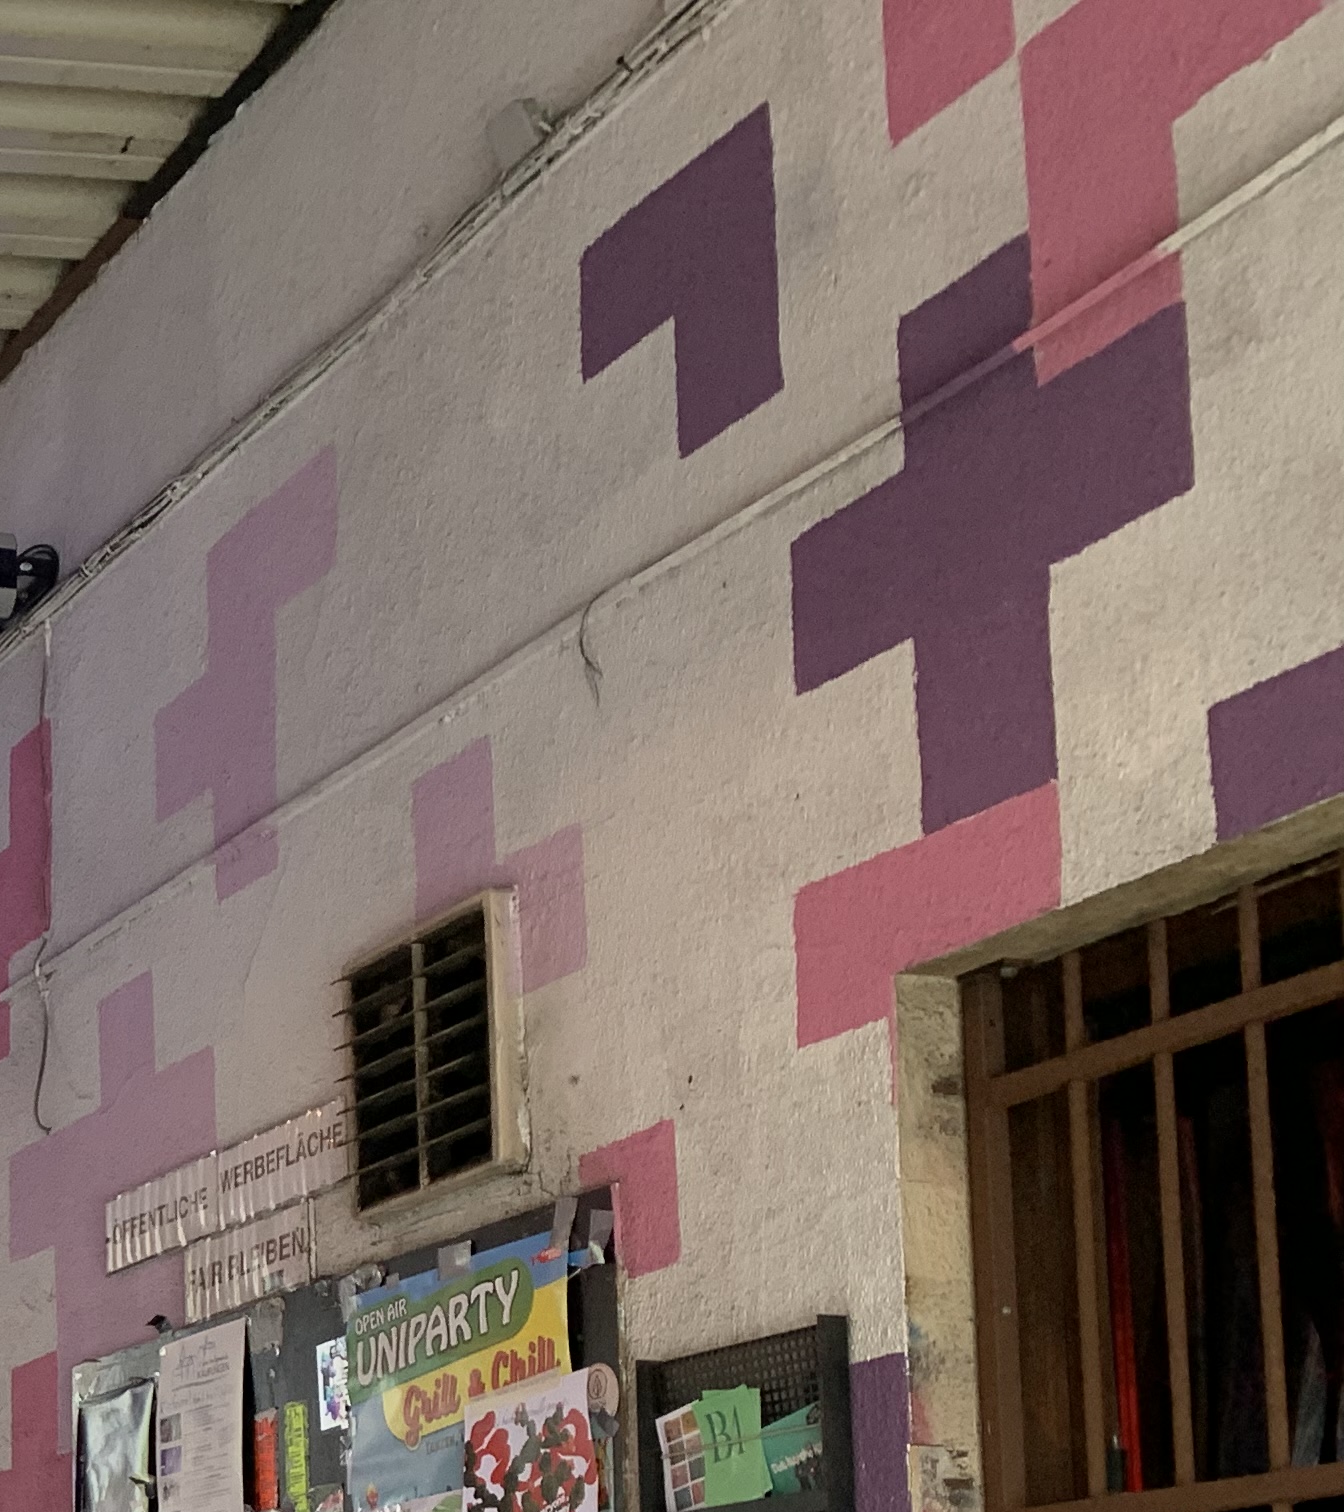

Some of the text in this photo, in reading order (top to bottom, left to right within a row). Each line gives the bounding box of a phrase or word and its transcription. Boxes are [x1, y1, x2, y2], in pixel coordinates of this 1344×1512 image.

[112, 1121, 343, 1245] ÖFFENTLICHE WERBEFLÄCHE
[355, 1298, 407, 1335] OPEN AIR
[356, 1269, 520, 1386] UNIPARTY
[403, 1373, 462, 1450] Grill
